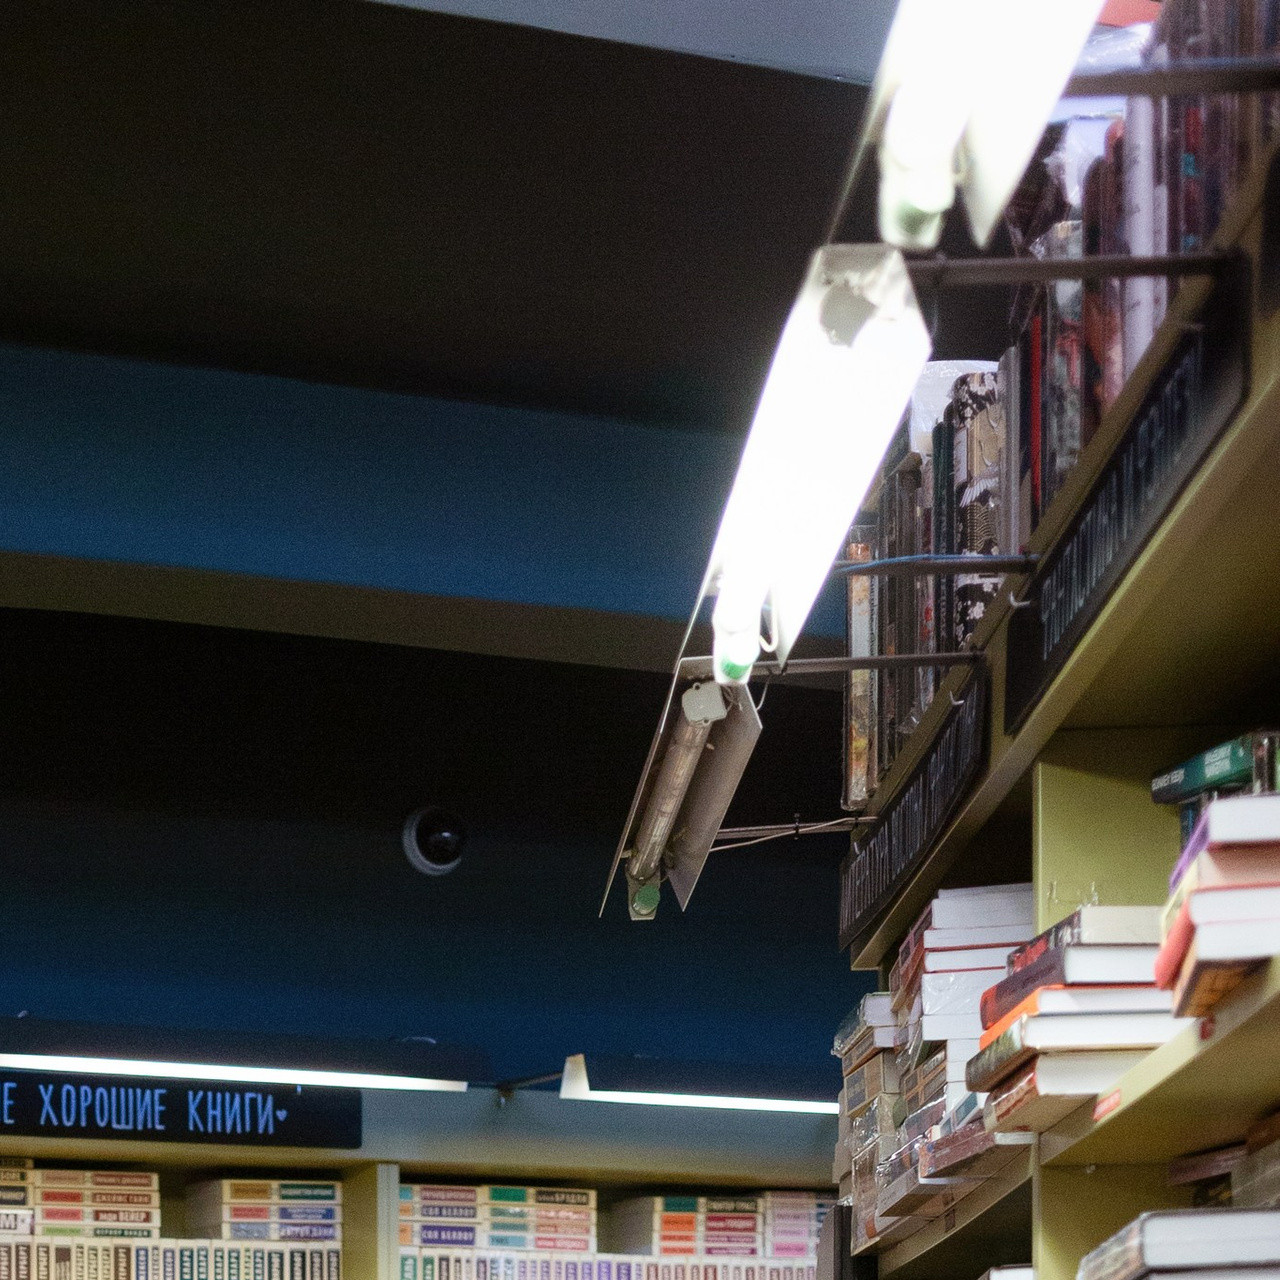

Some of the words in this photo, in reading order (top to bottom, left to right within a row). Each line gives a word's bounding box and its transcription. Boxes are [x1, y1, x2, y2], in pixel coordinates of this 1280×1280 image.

[39, 1085, 167, 1131] ХОРОШИЕ
[187, 1091, 275, 1135] КНИГИ
[182, 1250, 193, 1279] КЛАРК
[198, 1250, 208, 1279] КЛАРК
[229, 1250, 240, 1279] КЛАРК
